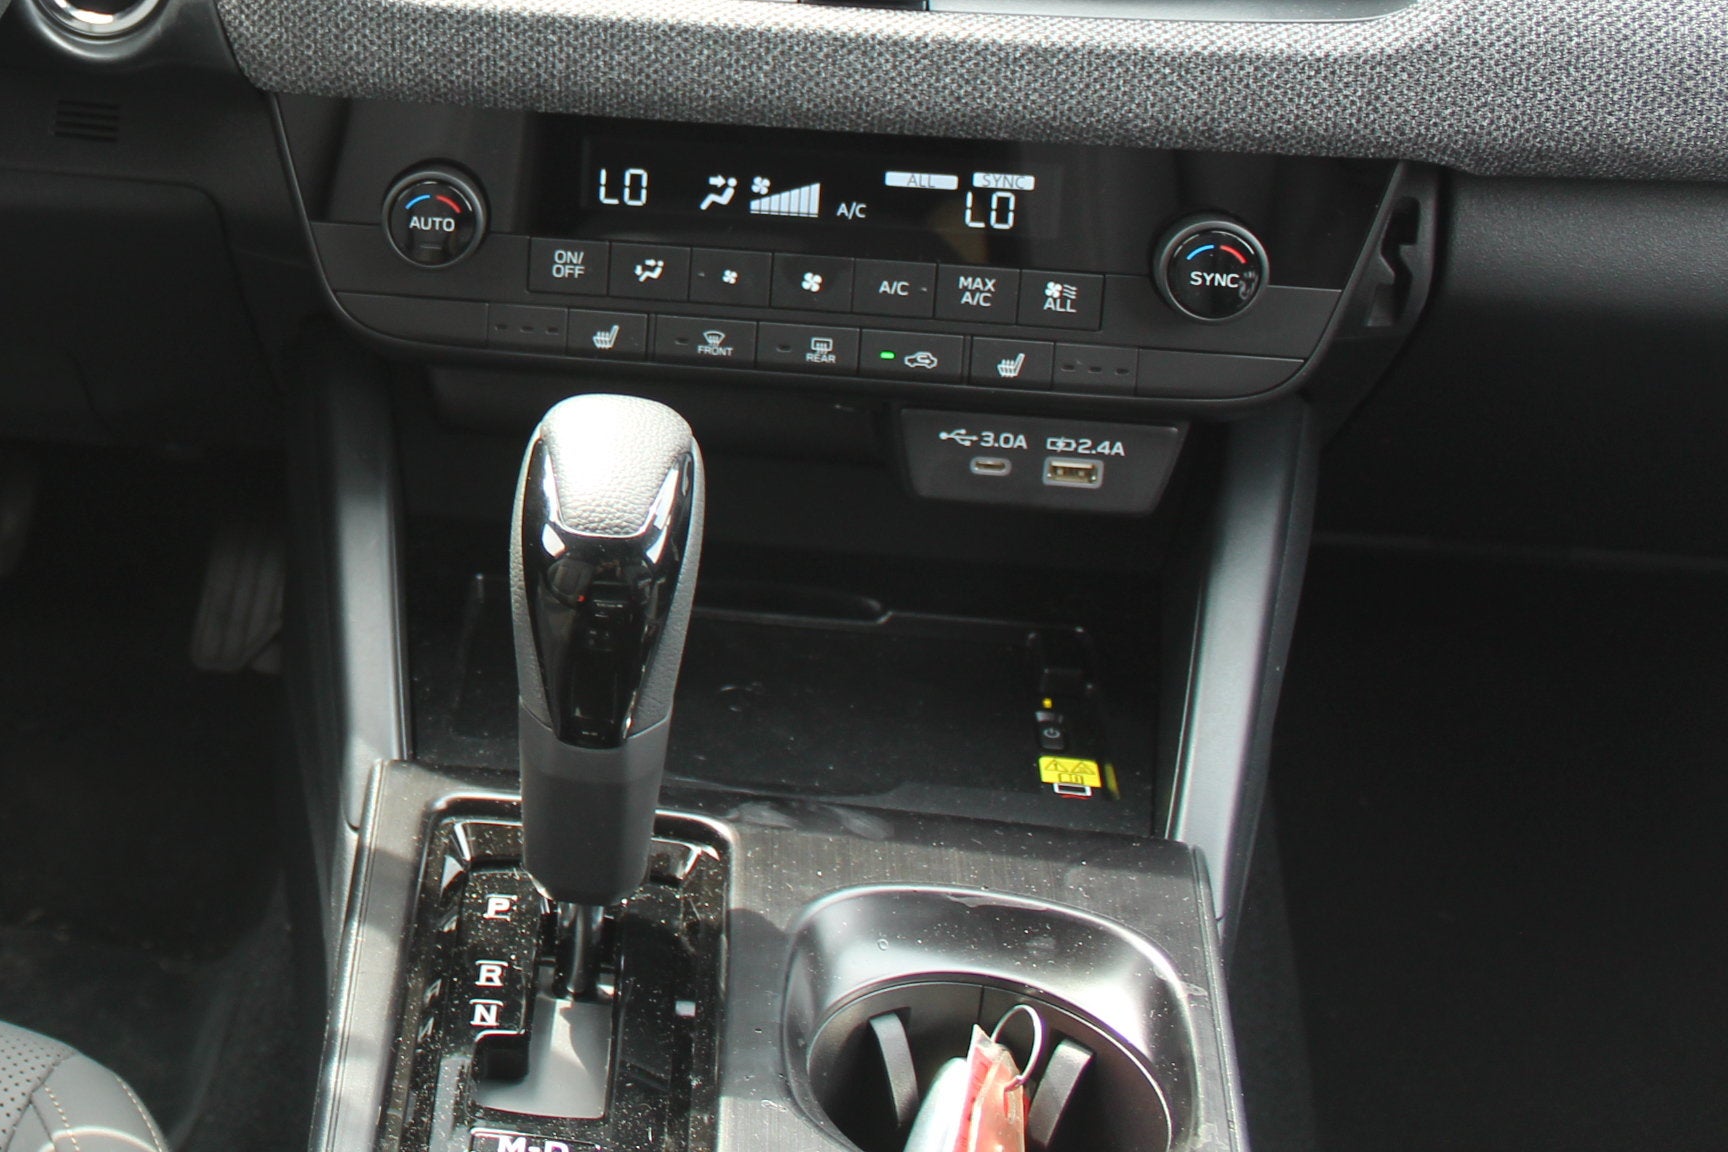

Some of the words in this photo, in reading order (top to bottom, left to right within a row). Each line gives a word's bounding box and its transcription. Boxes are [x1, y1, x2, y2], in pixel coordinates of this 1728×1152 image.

[907, 173, 936, 188] ALL
[982, 175, 1025, 189] SYNC
[836, 201, 867, 219] A/C
[409, 216, 455, 233] AUTO
[554, 250, 584, 265] ON/
[552, 264, 585, 279] OFF
[1190, 270, 1239, 289] SYNC
[879, 280, 909, 296] A/C
[958, 276, 996, 292] MAX
[960, 291, 992, 307] A/C
[1043, 297, 1076, 313] ALL
[697, 345, 733, 357] FRONT
[806, 352, 836, 364] REAR
[979, 431, 1028, 449] 3.0A
[1077, 439, 1125, 456] 2.4A
[485, 898, 511, 916] P
[478, 964, 505, 984] R
[472, 1004, 498, 1024] N
